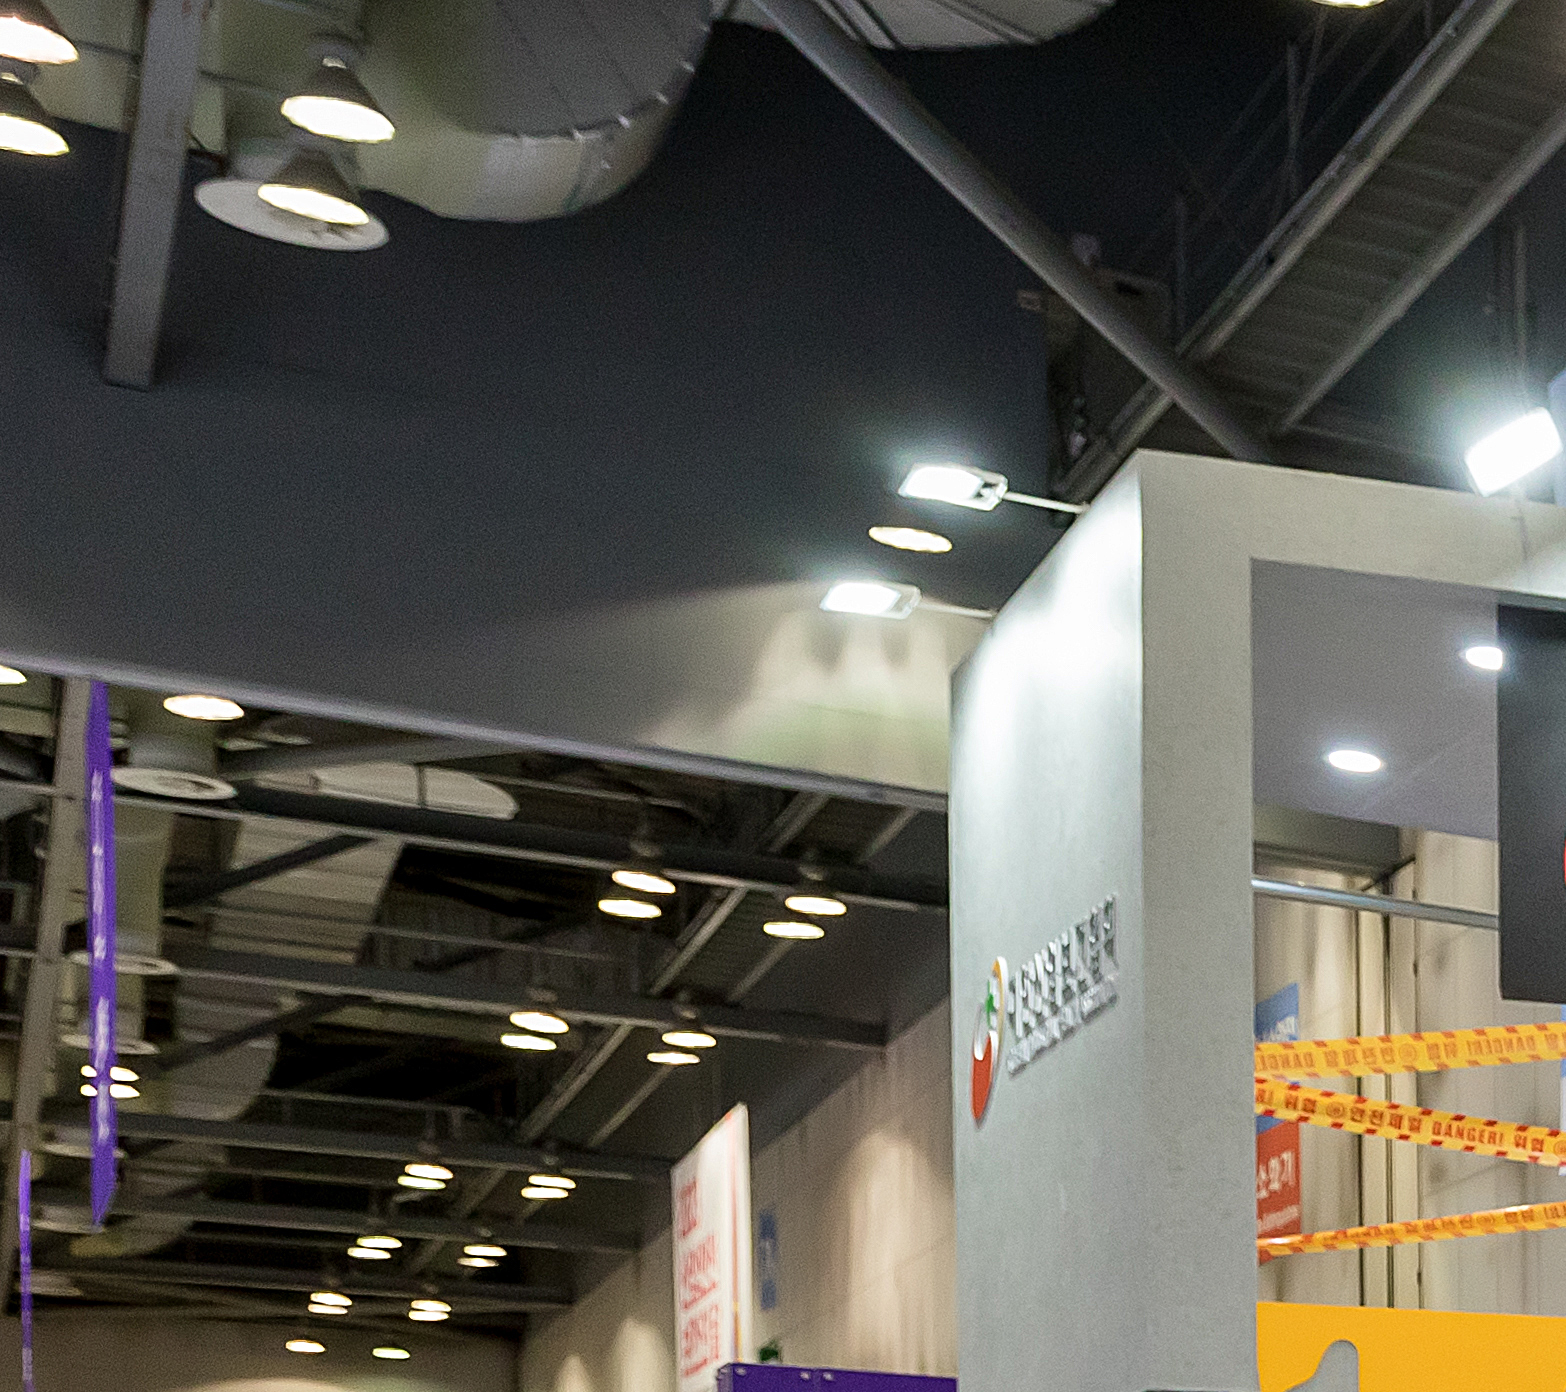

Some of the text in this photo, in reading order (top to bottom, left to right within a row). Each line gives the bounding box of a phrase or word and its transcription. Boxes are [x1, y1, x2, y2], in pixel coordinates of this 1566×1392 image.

[1285, 1094, 1317, 1114] 위험
[1349, 1106, 1422, 1133] 안전제일
[1431, 1121, 1504, 1148] DANGER!
